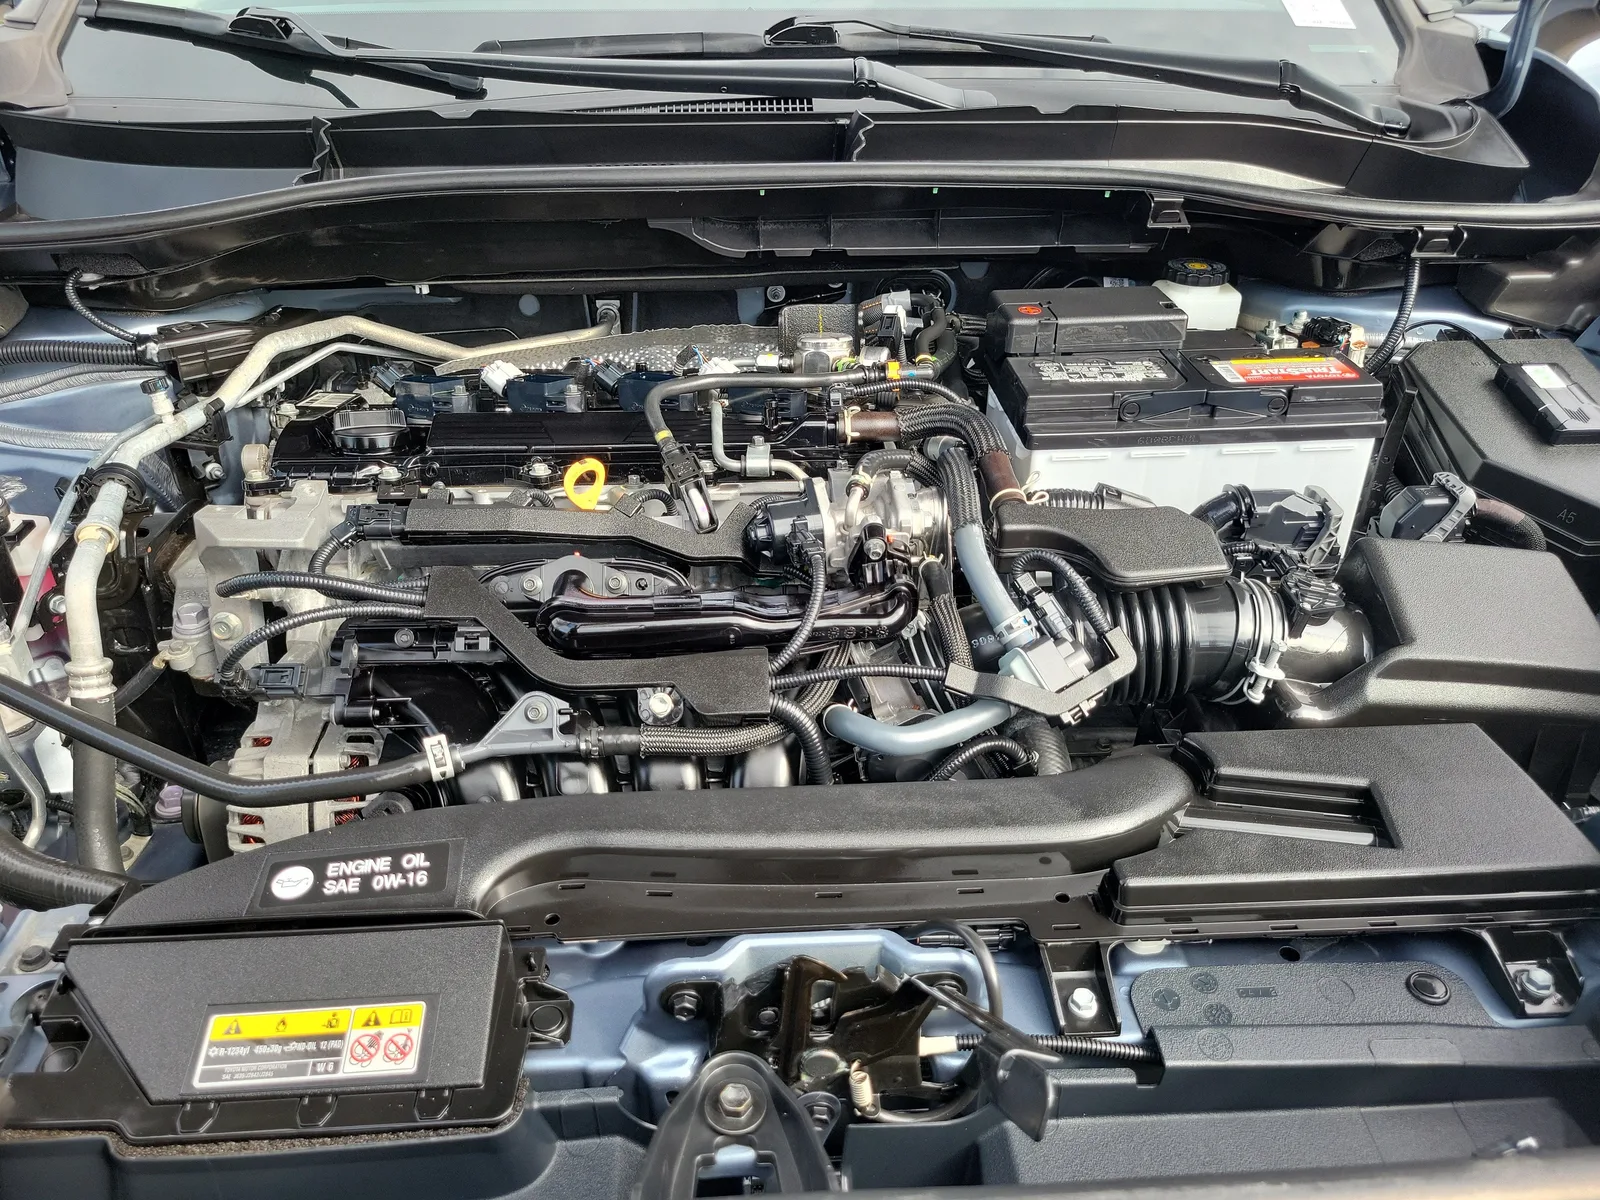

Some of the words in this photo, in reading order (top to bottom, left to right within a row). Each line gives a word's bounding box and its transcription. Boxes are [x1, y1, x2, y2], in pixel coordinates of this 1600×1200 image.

[1556, 509, 1577, 524] A5
[326, 857, 392, 877] ENGINE
[401, 853, 430, 869] OIL
[322, 878, 361, 895] SAE
[371, 870, 428, 891] 0W-16
[320, 1040, 328, 1050] 12
[316, 1062, 326, 1073] W
[327, 1061, 334, 1072] 6
